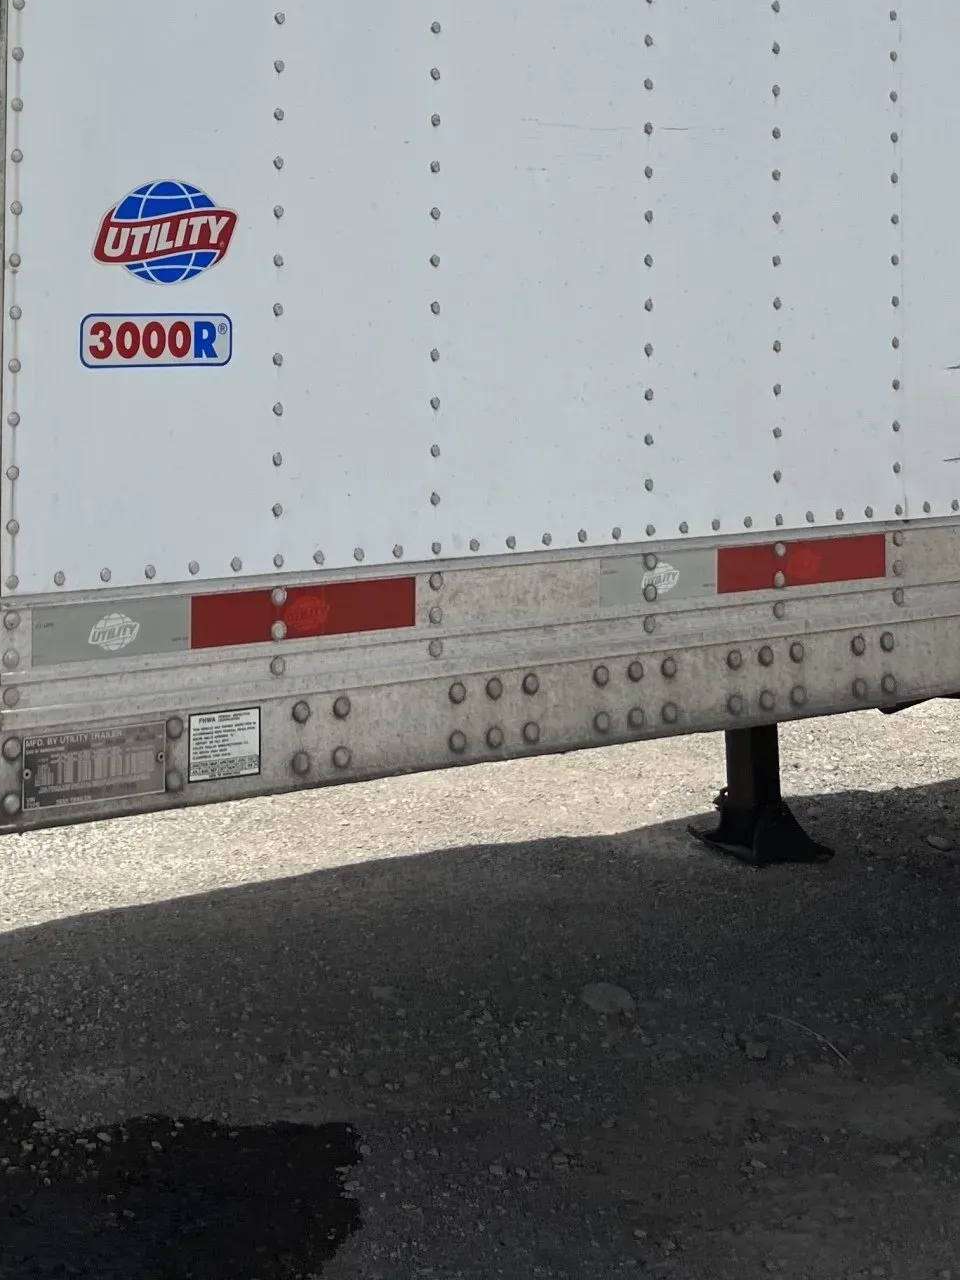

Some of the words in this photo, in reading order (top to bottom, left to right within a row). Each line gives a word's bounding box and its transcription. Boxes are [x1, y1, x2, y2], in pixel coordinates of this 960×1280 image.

[103, 215, 230, 258] UTILITY
[92, 623, 138, 643] UTILITY
[59, 732, 89, 745] UTILITY
[91, 729, 122, 741] TRAILER
